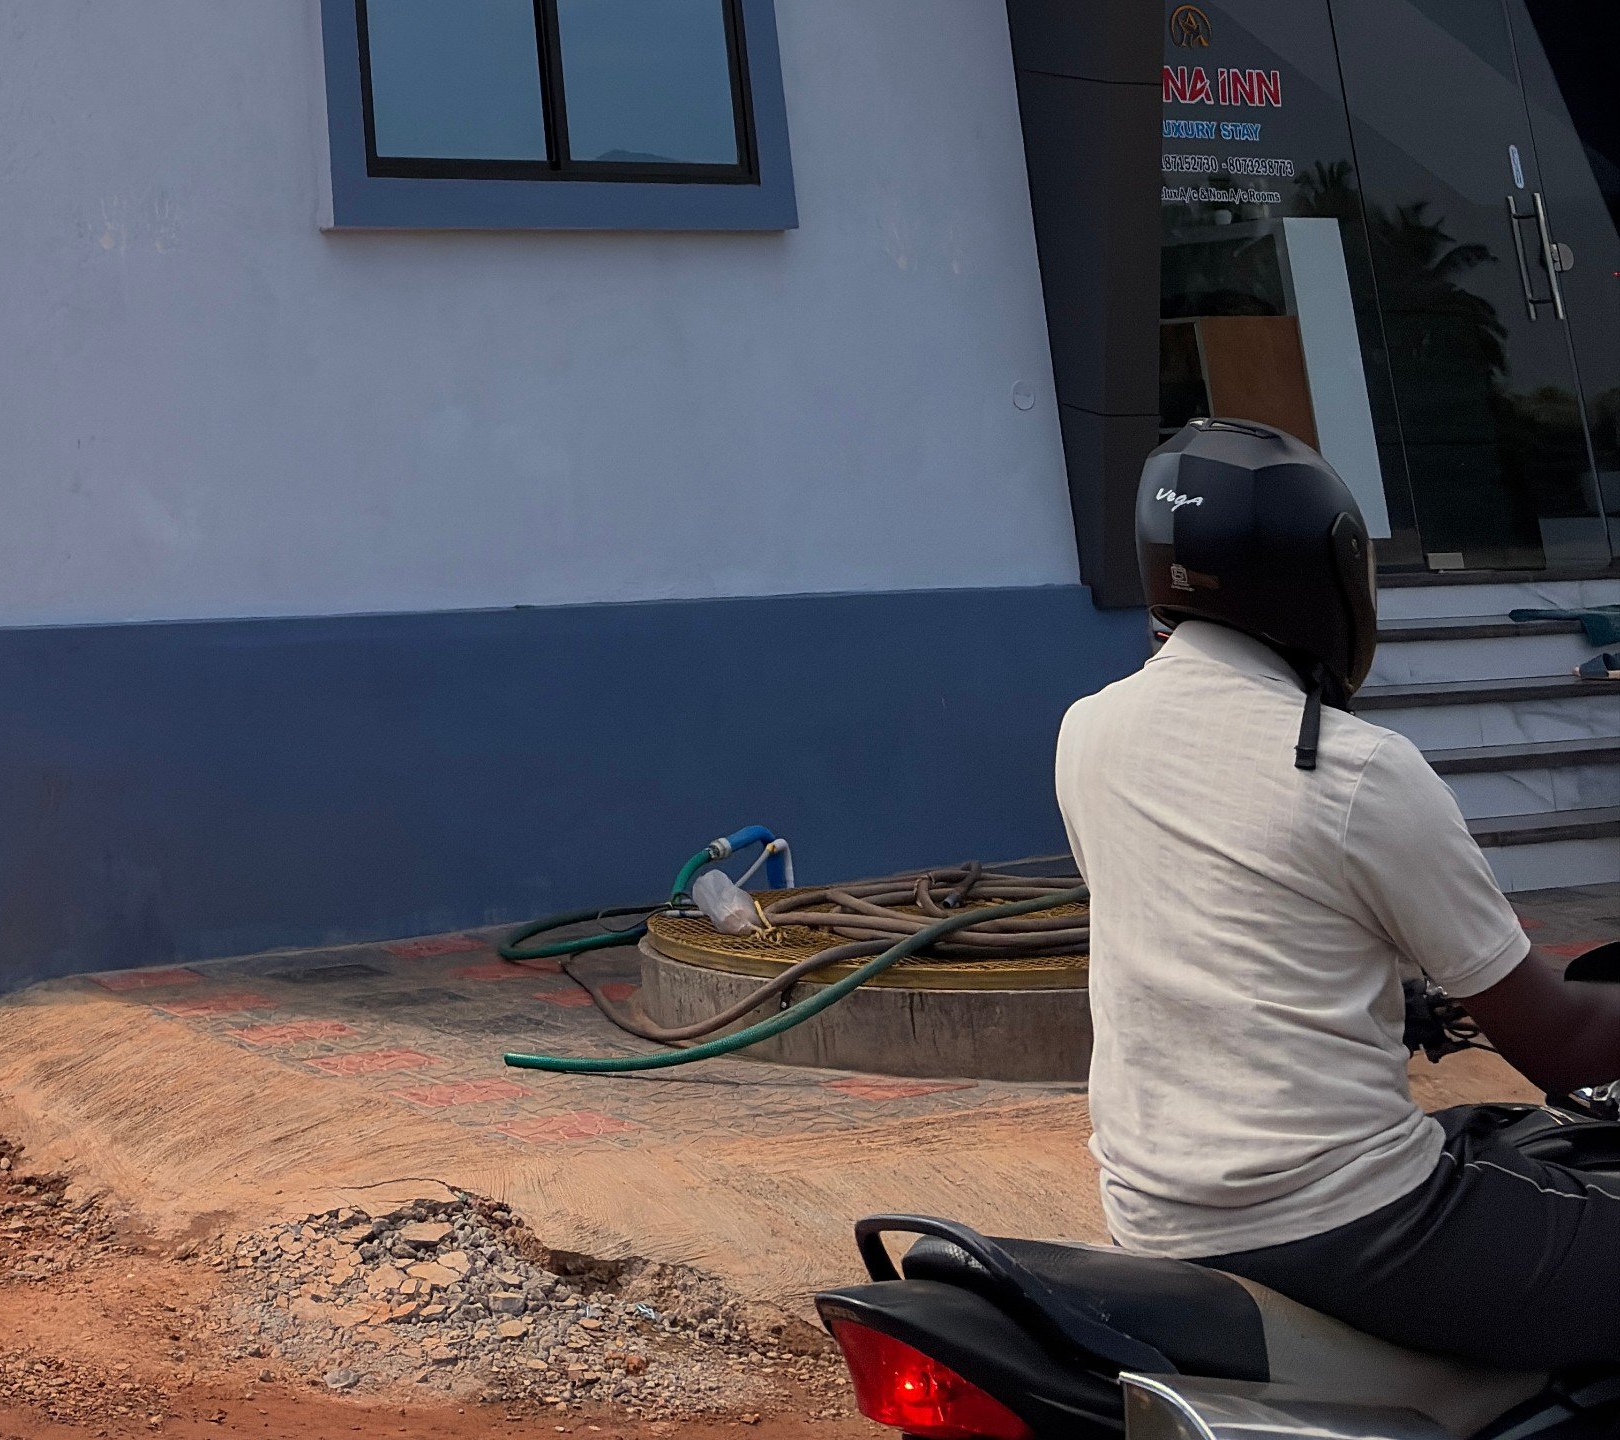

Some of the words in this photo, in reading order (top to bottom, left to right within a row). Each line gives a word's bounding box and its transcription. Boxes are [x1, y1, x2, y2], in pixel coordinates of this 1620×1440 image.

[1218, 68, 1282, 107] INN
[1220, 122, 1261, 141] STAY
[1199, 188, 1210, 201] &
[1209, 188, 1229, 202] Non
[1248, 189, 1281, 203] Rooms
